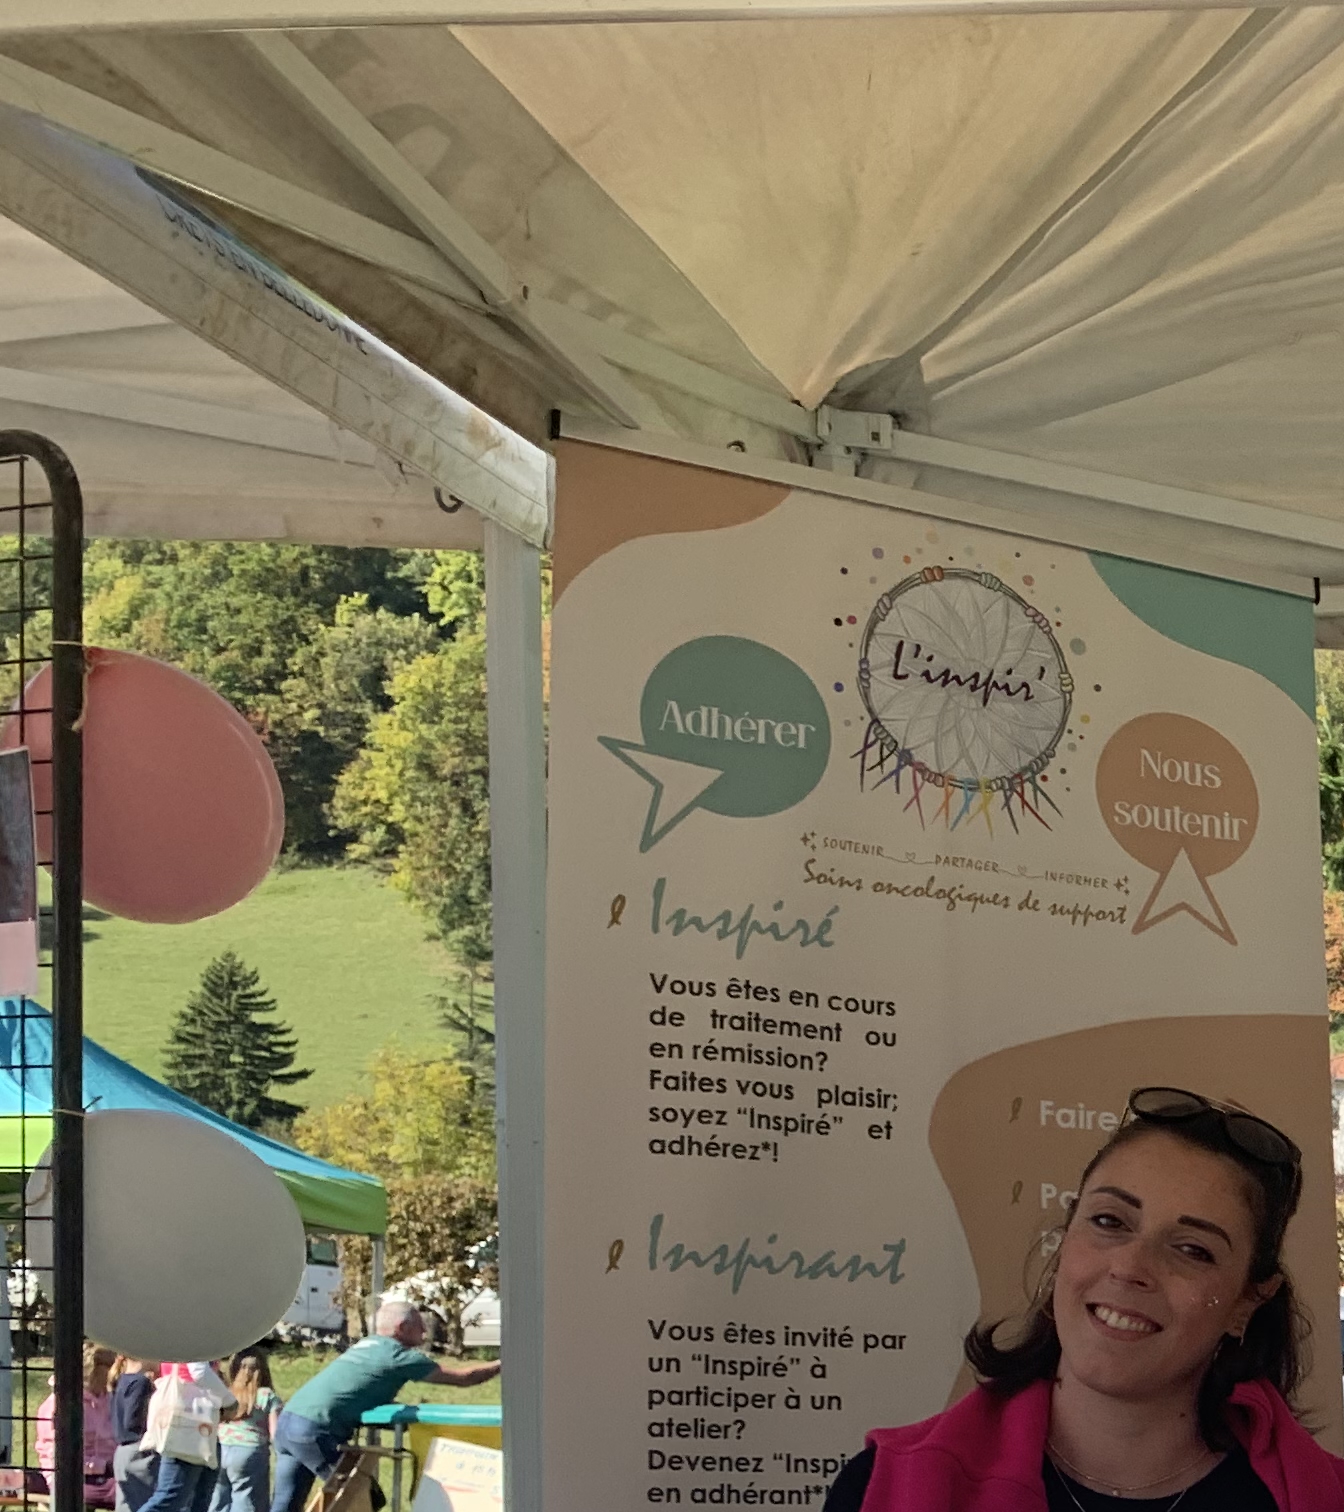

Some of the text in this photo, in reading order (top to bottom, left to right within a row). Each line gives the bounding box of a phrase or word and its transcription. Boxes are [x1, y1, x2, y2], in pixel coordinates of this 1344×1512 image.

[659, 700, 816, 749] Adhérer
[1140, 748, 1222, 789] Nous
[1113, 801, 1248, 841] soutenir
[822, 836, 1109, 889] SOUTENIR PARTAGER INFORMER
[803, 857, 1127, 927] Soins oncologiques de support
[651, 877, 840, 961] Inspiré
[649, 972, 896, 1017] Vous êtes en cours
[649, 1005, 897, 1048] de traitement ou
[648, 1038, 829, 1073] en rémission?
[649, 1069, 898, 1112] Faites vous plaisir;
[648, 1106, 893, 1141] soyez "Inspiré" et
[1040, 1099, 1119, 1132] Faire
[648, 1213, 906, 1296] Inspirant
[647, 1319, 907, 1354] Vous êtes invité par
[648, 1353, 827, 1381] un "Inspiré" à
[647, 1385, 842, 1413] participer à un
[647, 1417, 746, 1441] atelier?
[648, 1449, 845, 1481] Devenez "Inspi
[646, 1486, 681, 1504] en
